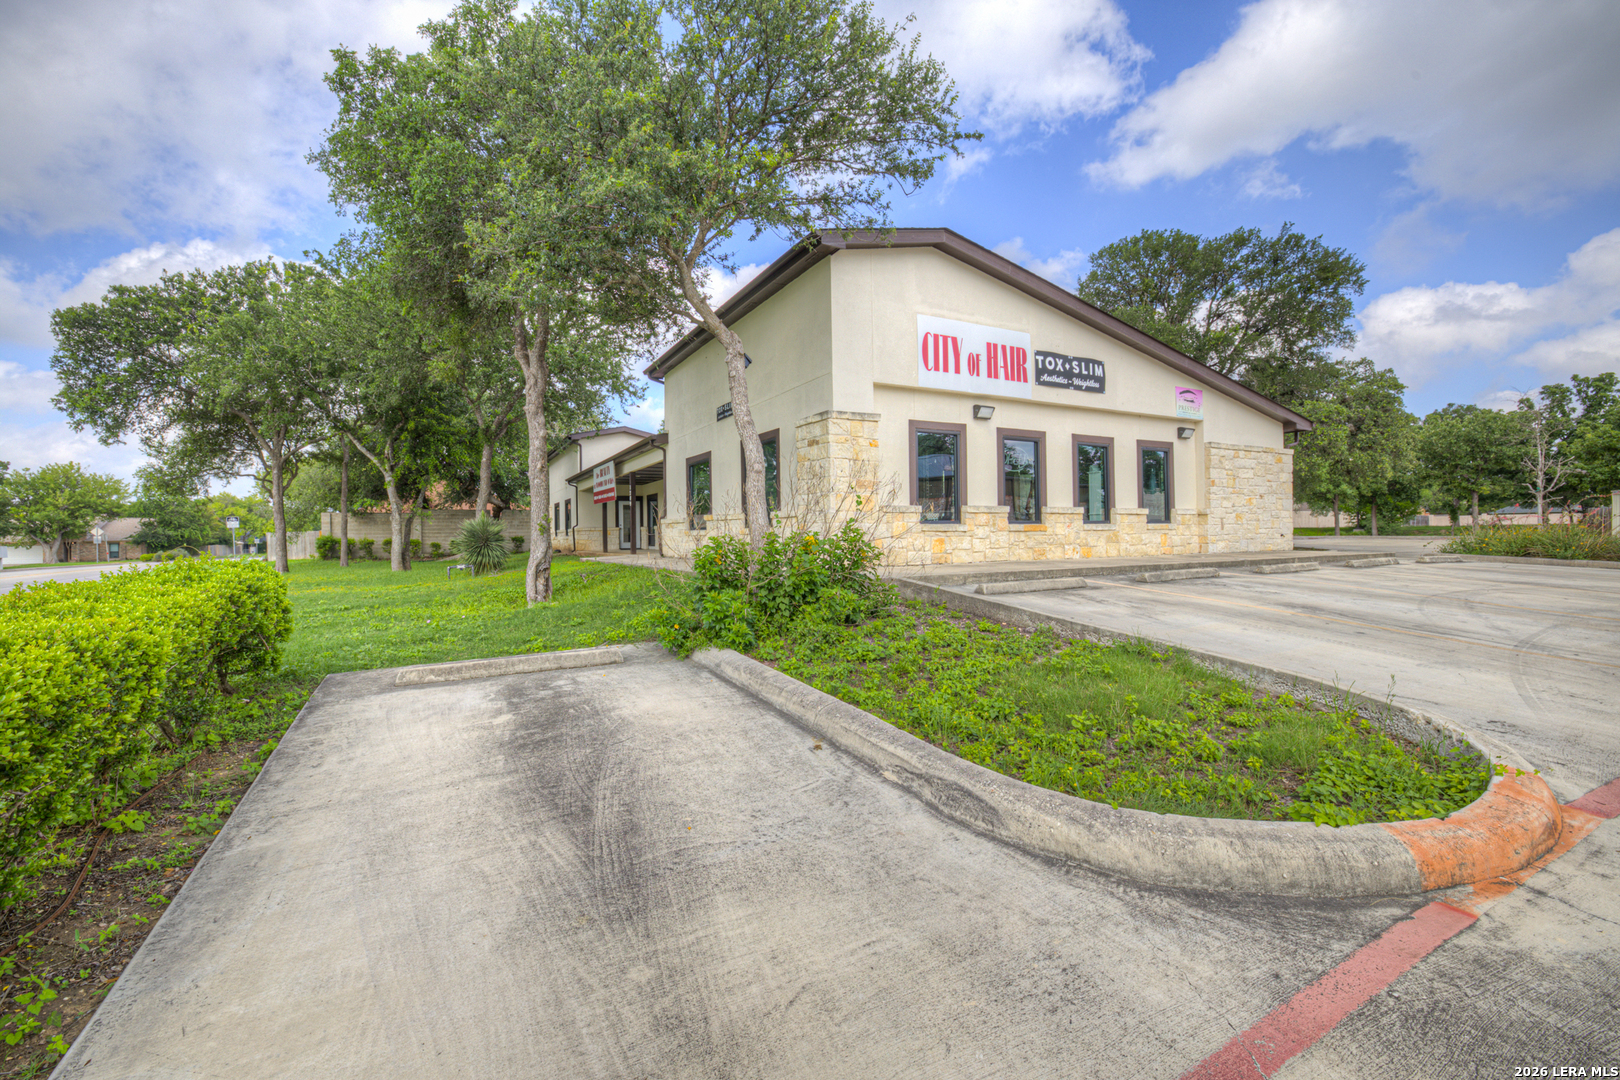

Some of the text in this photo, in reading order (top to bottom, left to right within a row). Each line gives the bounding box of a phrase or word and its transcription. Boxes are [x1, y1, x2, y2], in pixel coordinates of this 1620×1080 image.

[922, 331, 1028, 383] CITY OF HAIR
[1035, 355, 1103, 377] TOX SLIM
[1040, 373, 1068, 384] Aesthetics
